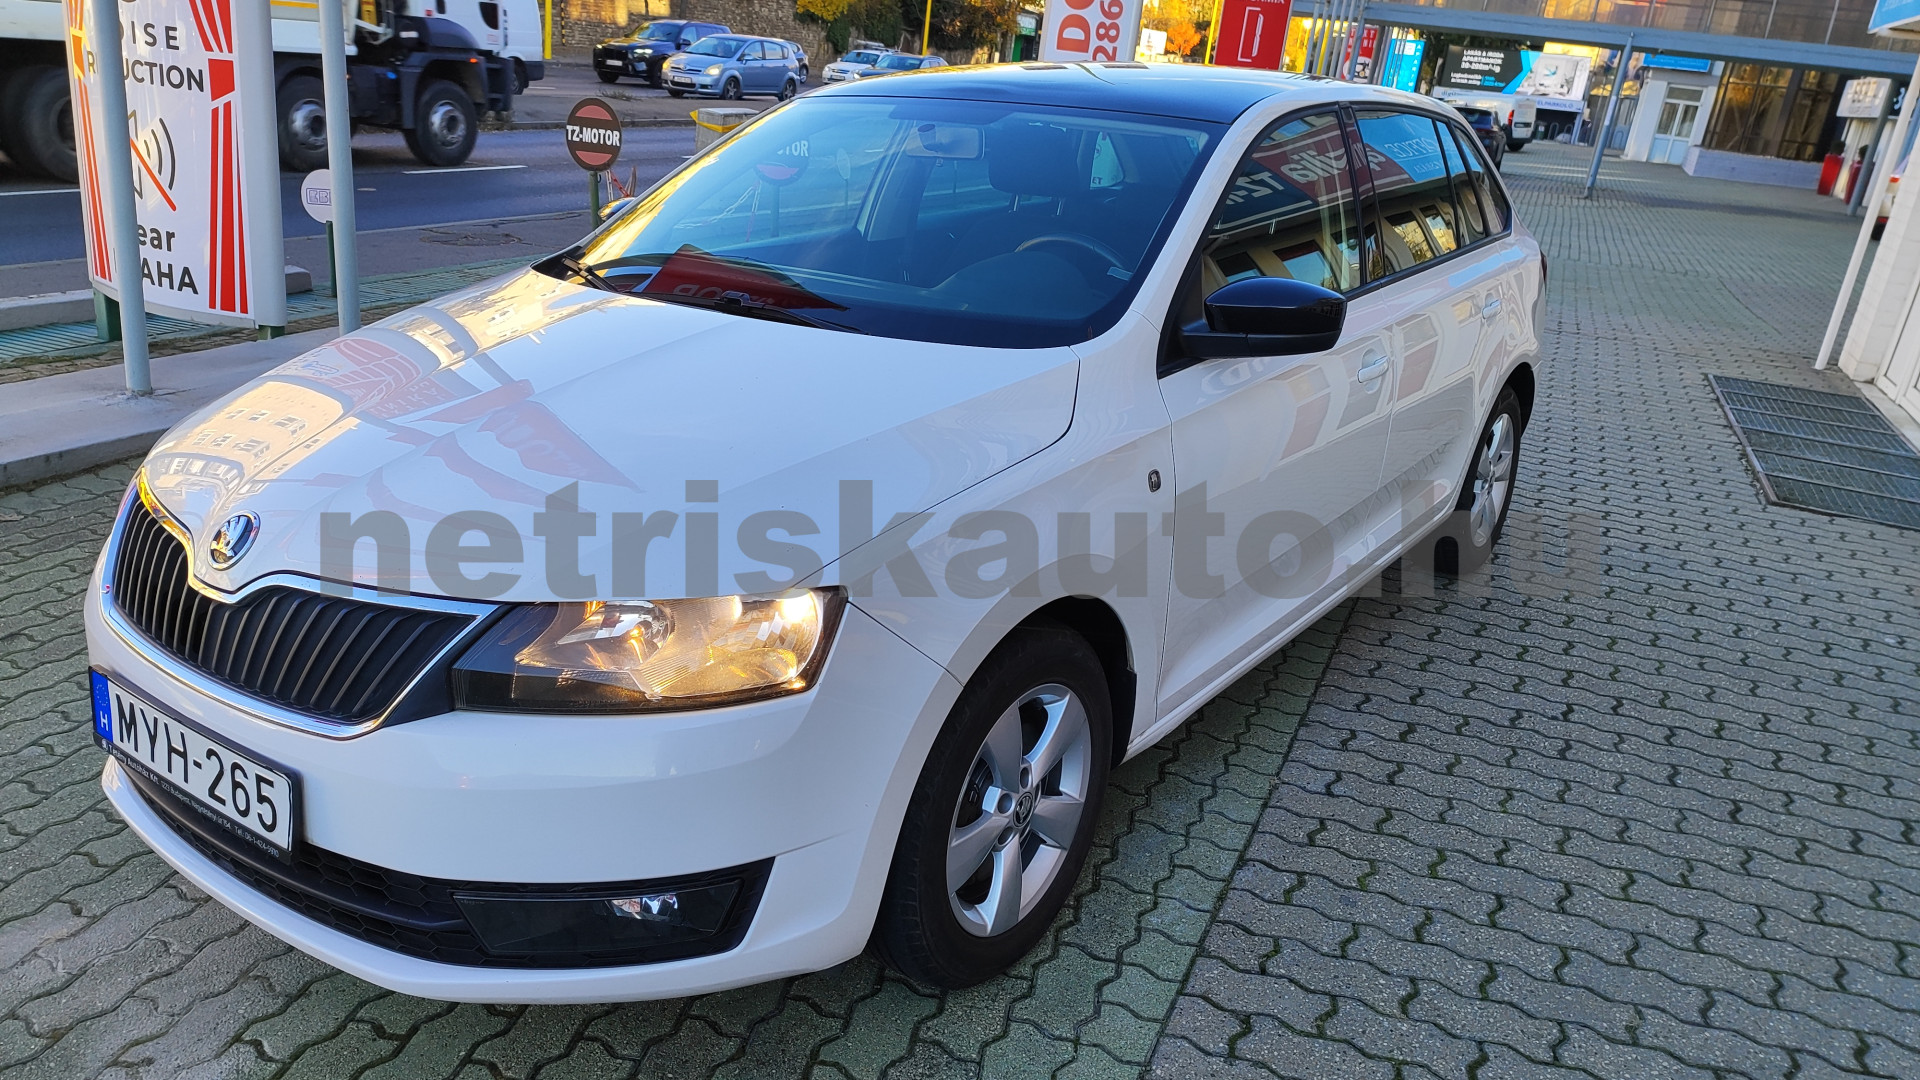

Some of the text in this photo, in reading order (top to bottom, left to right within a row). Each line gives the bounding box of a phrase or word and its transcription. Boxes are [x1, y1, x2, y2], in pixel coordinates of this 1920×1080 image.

[566, 124, 620, 147] TZ-MOTOR
[137, 224, 176, 252] ear
[100, 710, 109, 732] H
[115, 692, 277, 833] MYH-265
